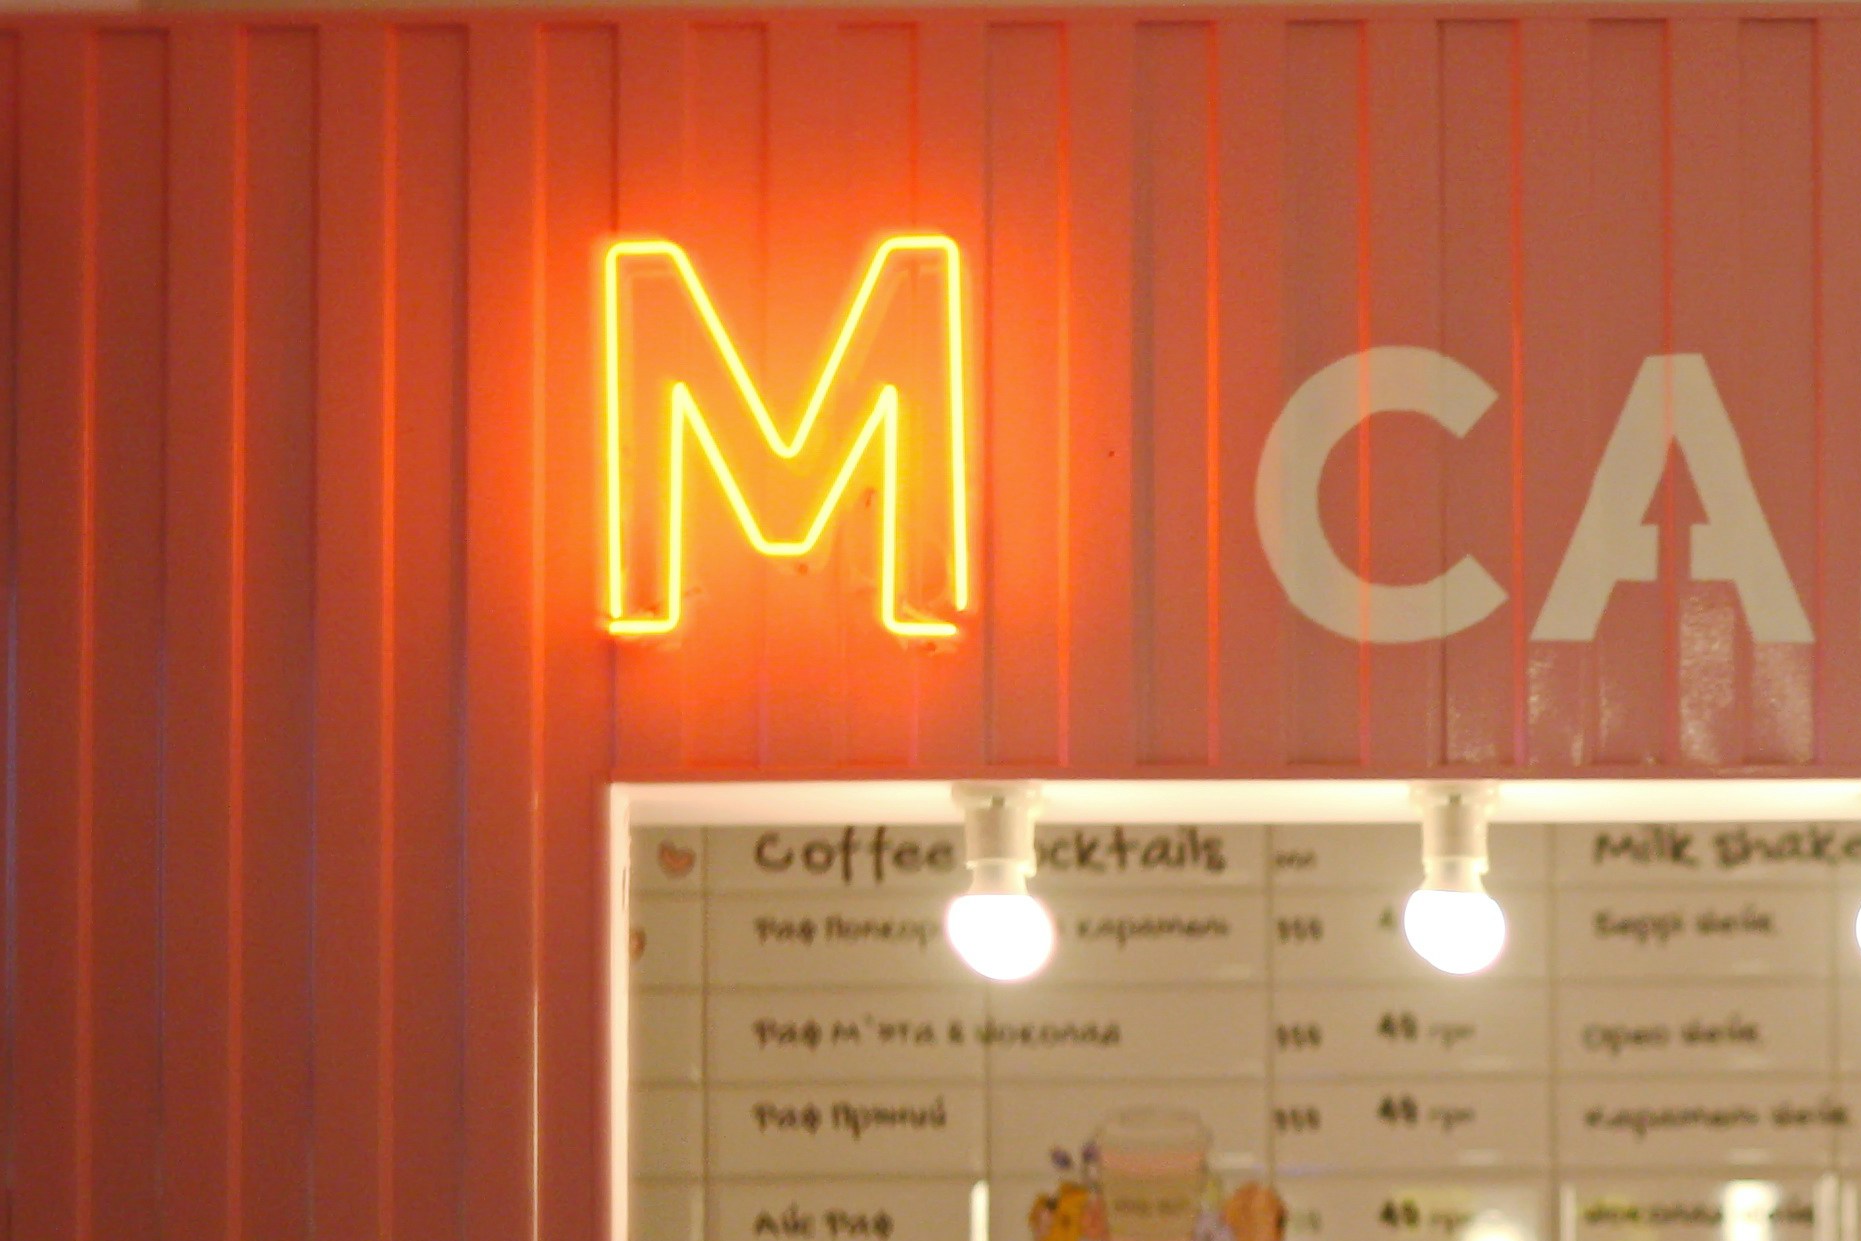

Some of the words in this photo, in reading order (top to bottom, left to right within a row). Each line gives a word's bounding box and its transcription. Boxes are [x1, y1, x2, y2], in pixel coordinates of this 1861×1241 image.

[598, 230, 974, 648] M
[753, 826, 957, 887] Coffee
[1591, 822, 1702, 868] Milk
